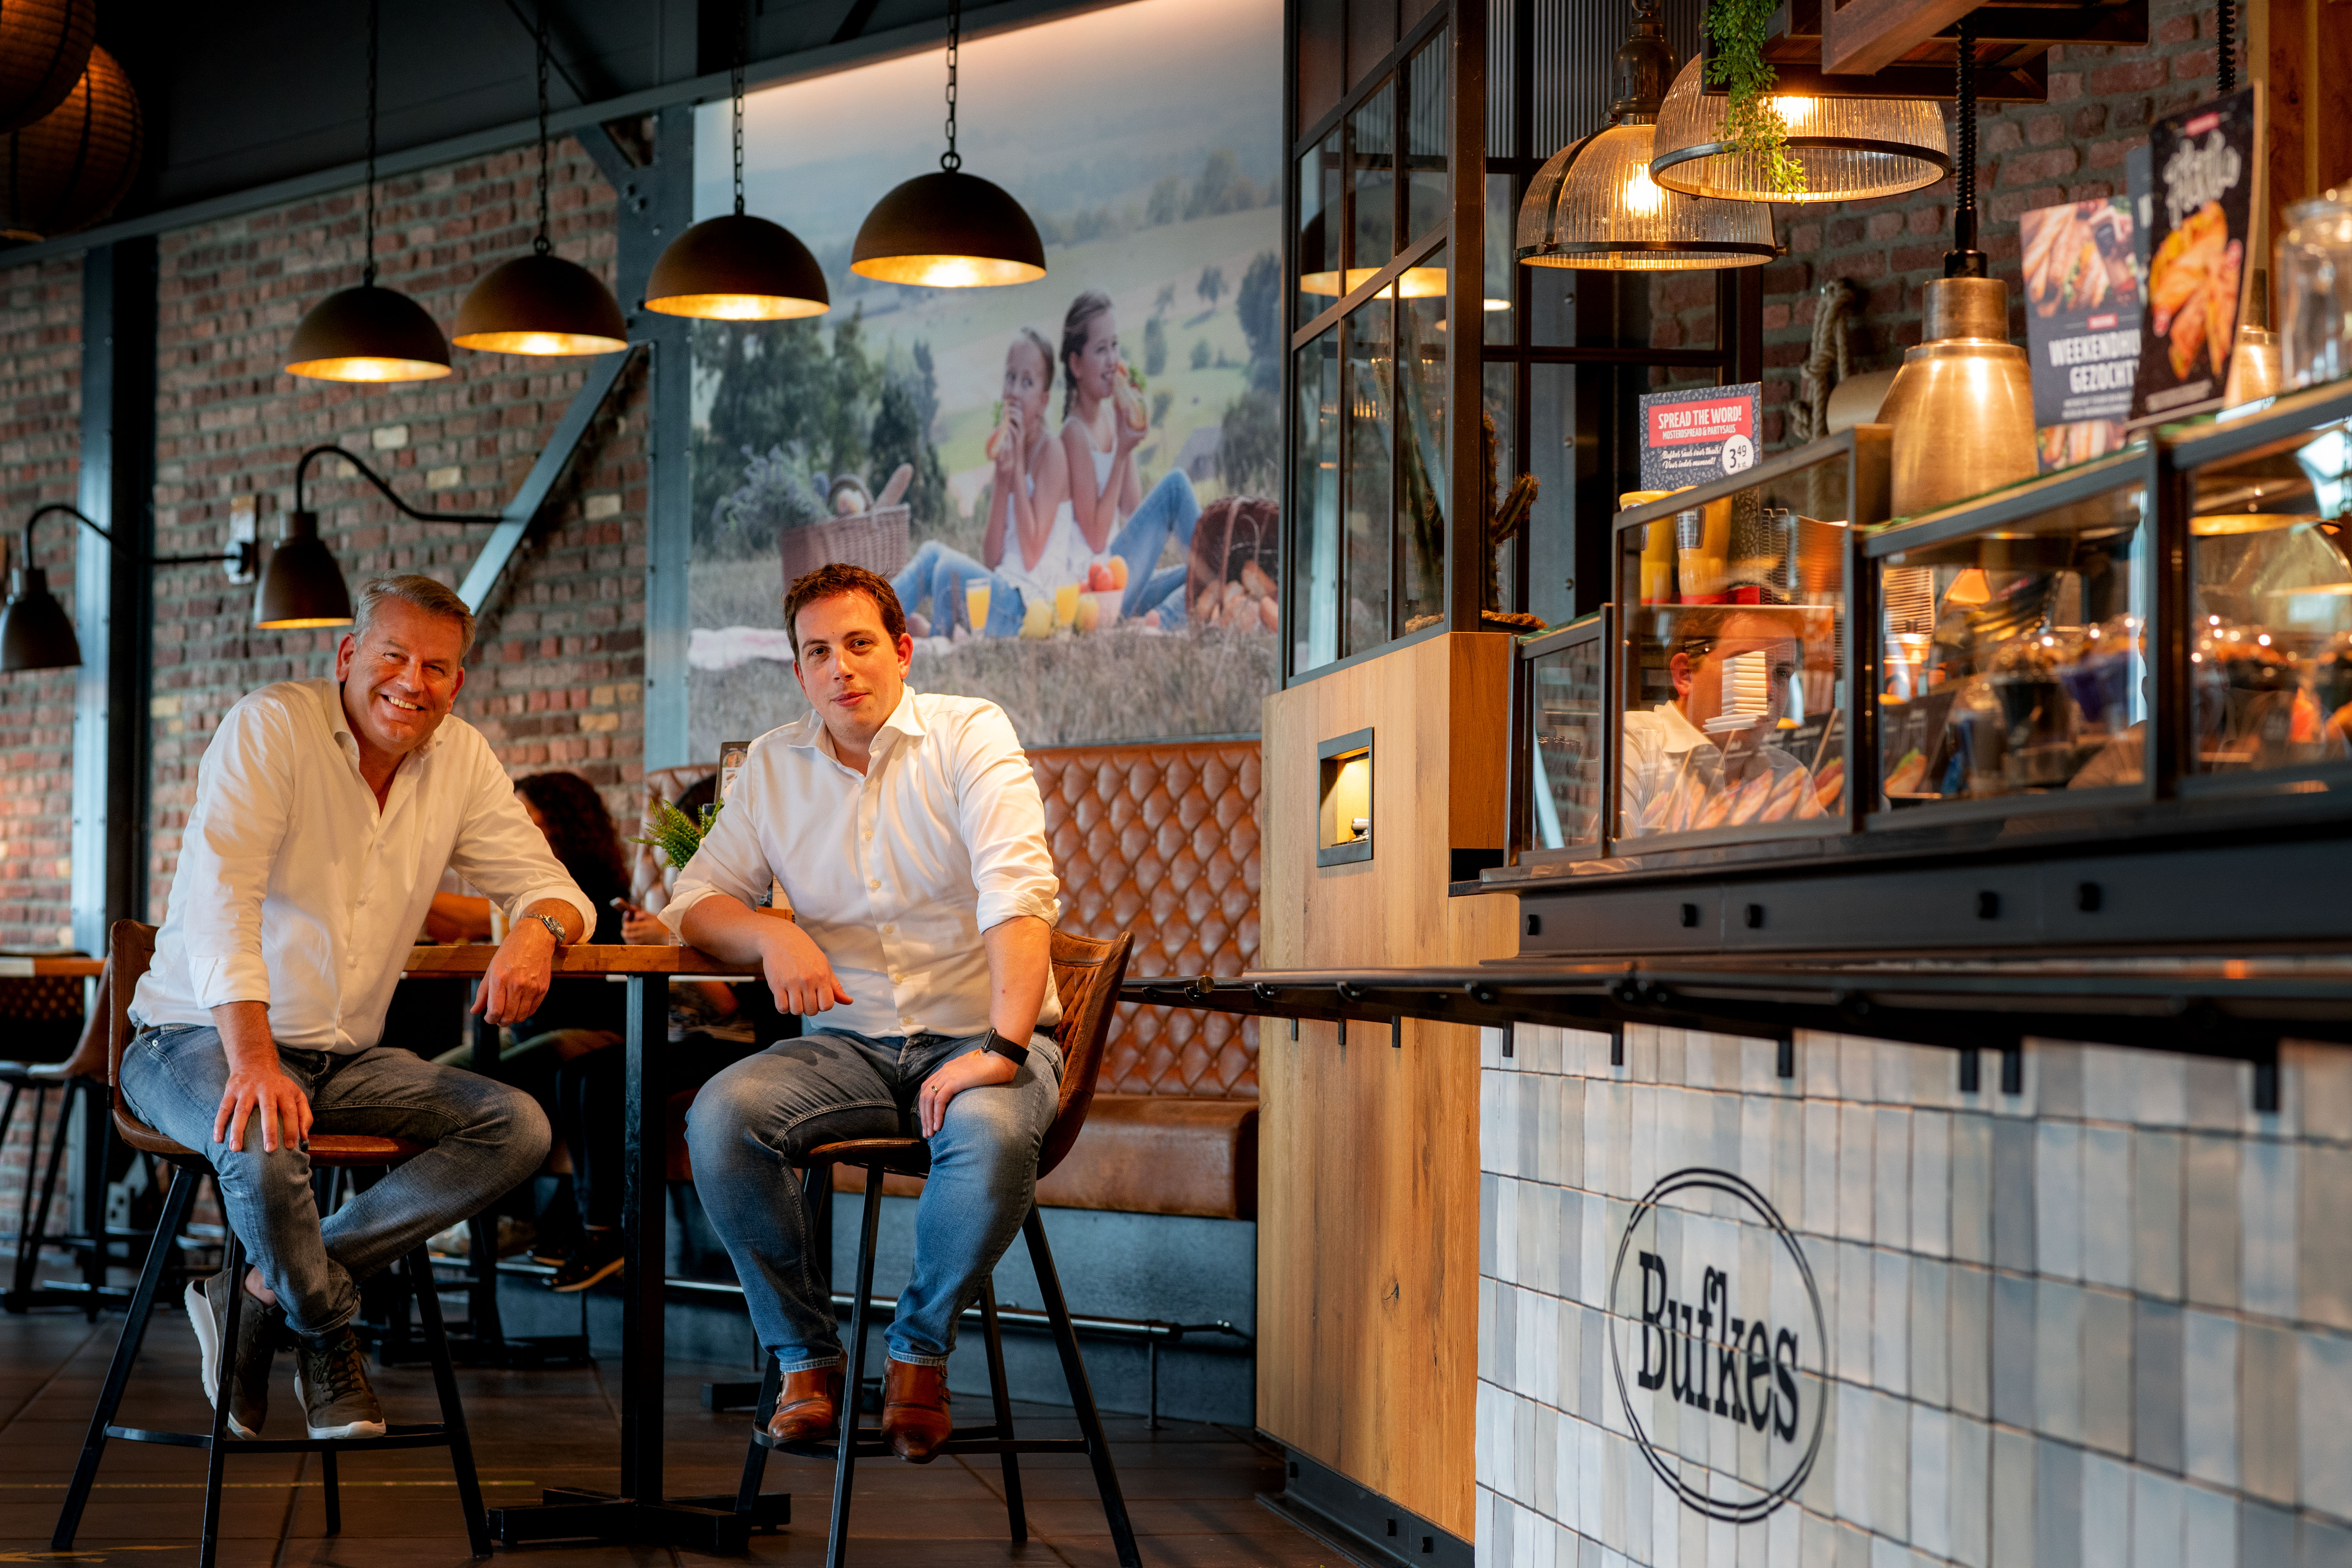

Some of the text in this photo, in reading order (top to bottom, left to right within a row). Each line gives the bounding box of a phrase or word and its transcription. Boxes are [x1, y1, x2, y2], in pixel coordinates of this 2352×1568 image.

[1658, 405, 1742, 429] SPREAD THE WORD!
[1662, 424, 1736, 439] MOSTERDSPREAD & PARTYSAUS
[1638, 1251, 1798, 1443] Bufkes
